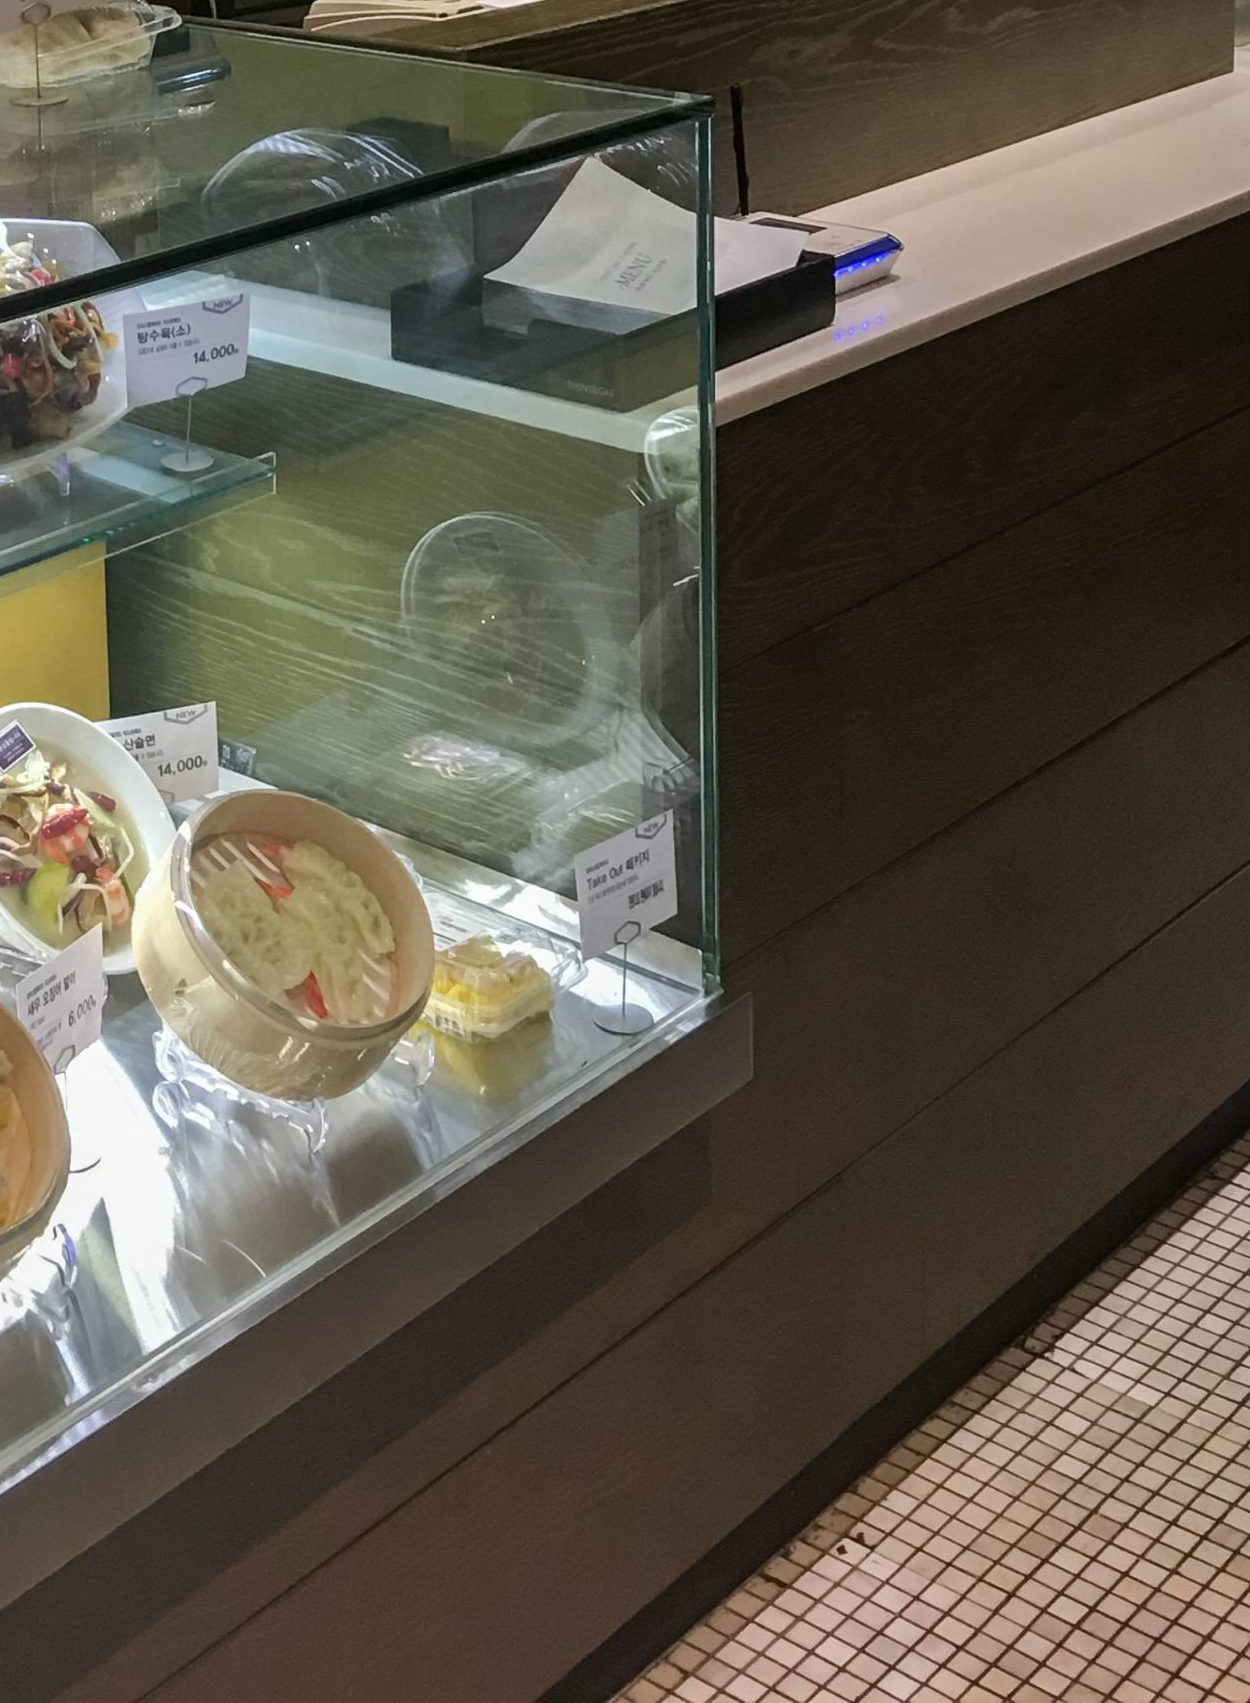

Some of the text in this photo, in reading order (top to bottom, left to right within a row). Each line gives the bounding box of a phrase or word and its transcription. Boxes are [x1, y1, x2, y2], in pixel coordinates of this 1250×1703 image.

[614, 252, 653, 288] MENU
[213, 299, 233, 309] NEW
[175, 710, 197, 720] NEW
[586, 874, 608, 891] Take
[609, 864, 624, 881] Out
